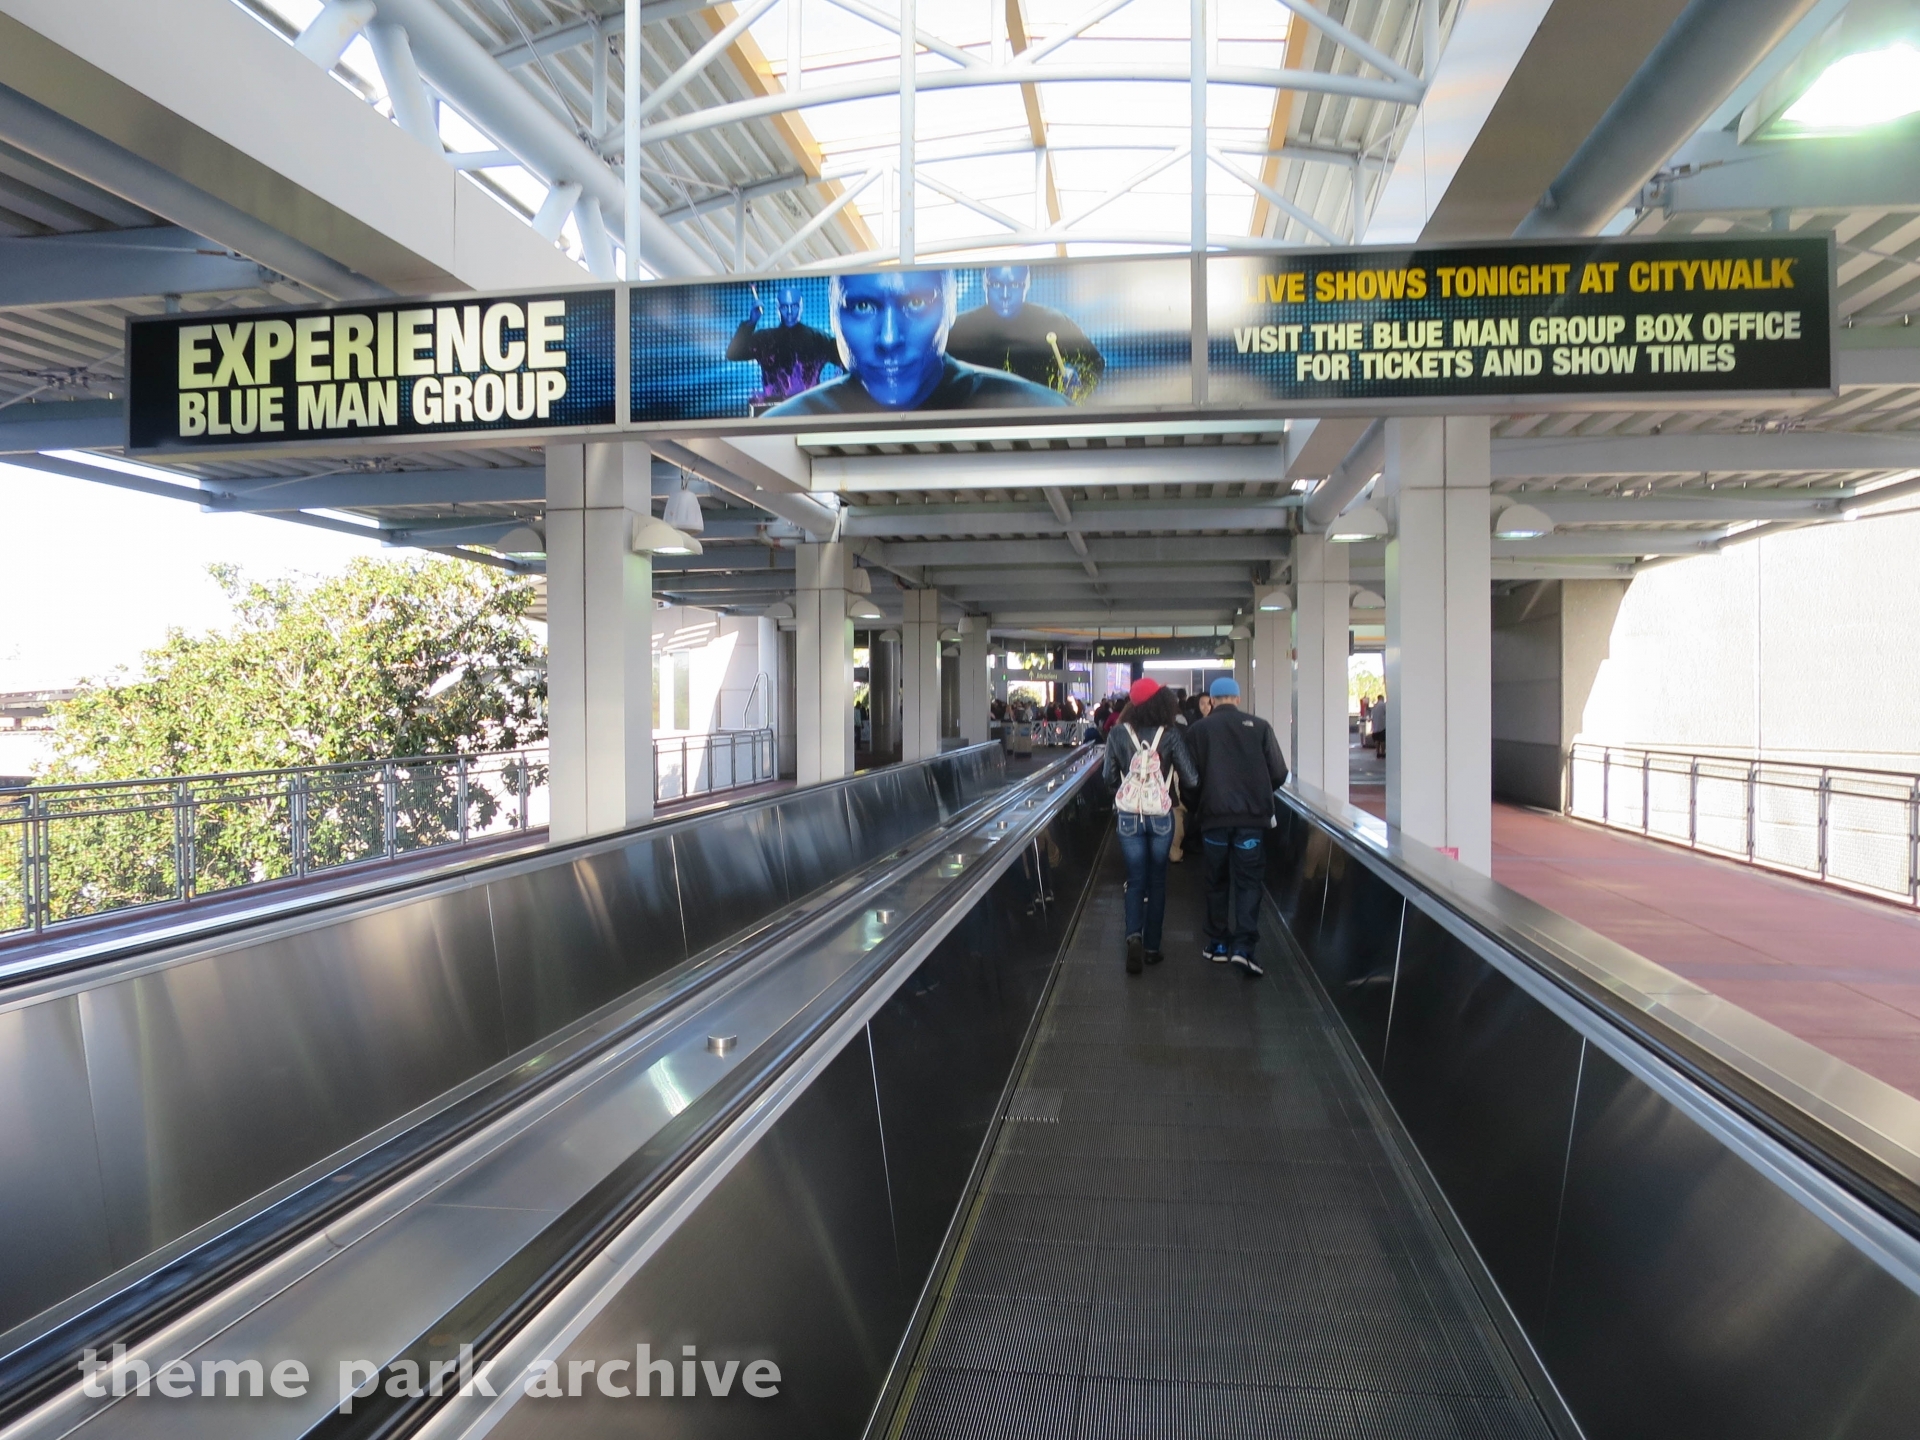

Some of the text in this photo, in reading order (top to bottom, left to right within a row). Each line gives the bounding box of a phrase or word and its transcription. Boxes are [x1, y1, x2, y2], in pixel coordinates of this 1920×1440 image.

[1315, 268, 1427, 301] SHOWS
[1436, 263, 1571, 297] TONIGHT
[1579, 262, 1619, 293] AT
[1629, 257, 1795, 292] CITYWALK
[178, 300, 567, 389] EXPERIENCE
[1233, 310, 1802, 353] VISIT THE BLUE MAN GROUP BOX OFFICE
[1296, 343, 1736, 382] FOR TICKETS AND SHOW TIMES
[179, 371, 567, 437] BLUE MAN GROUP
[1110, 645, 1161, 656] Attractions
